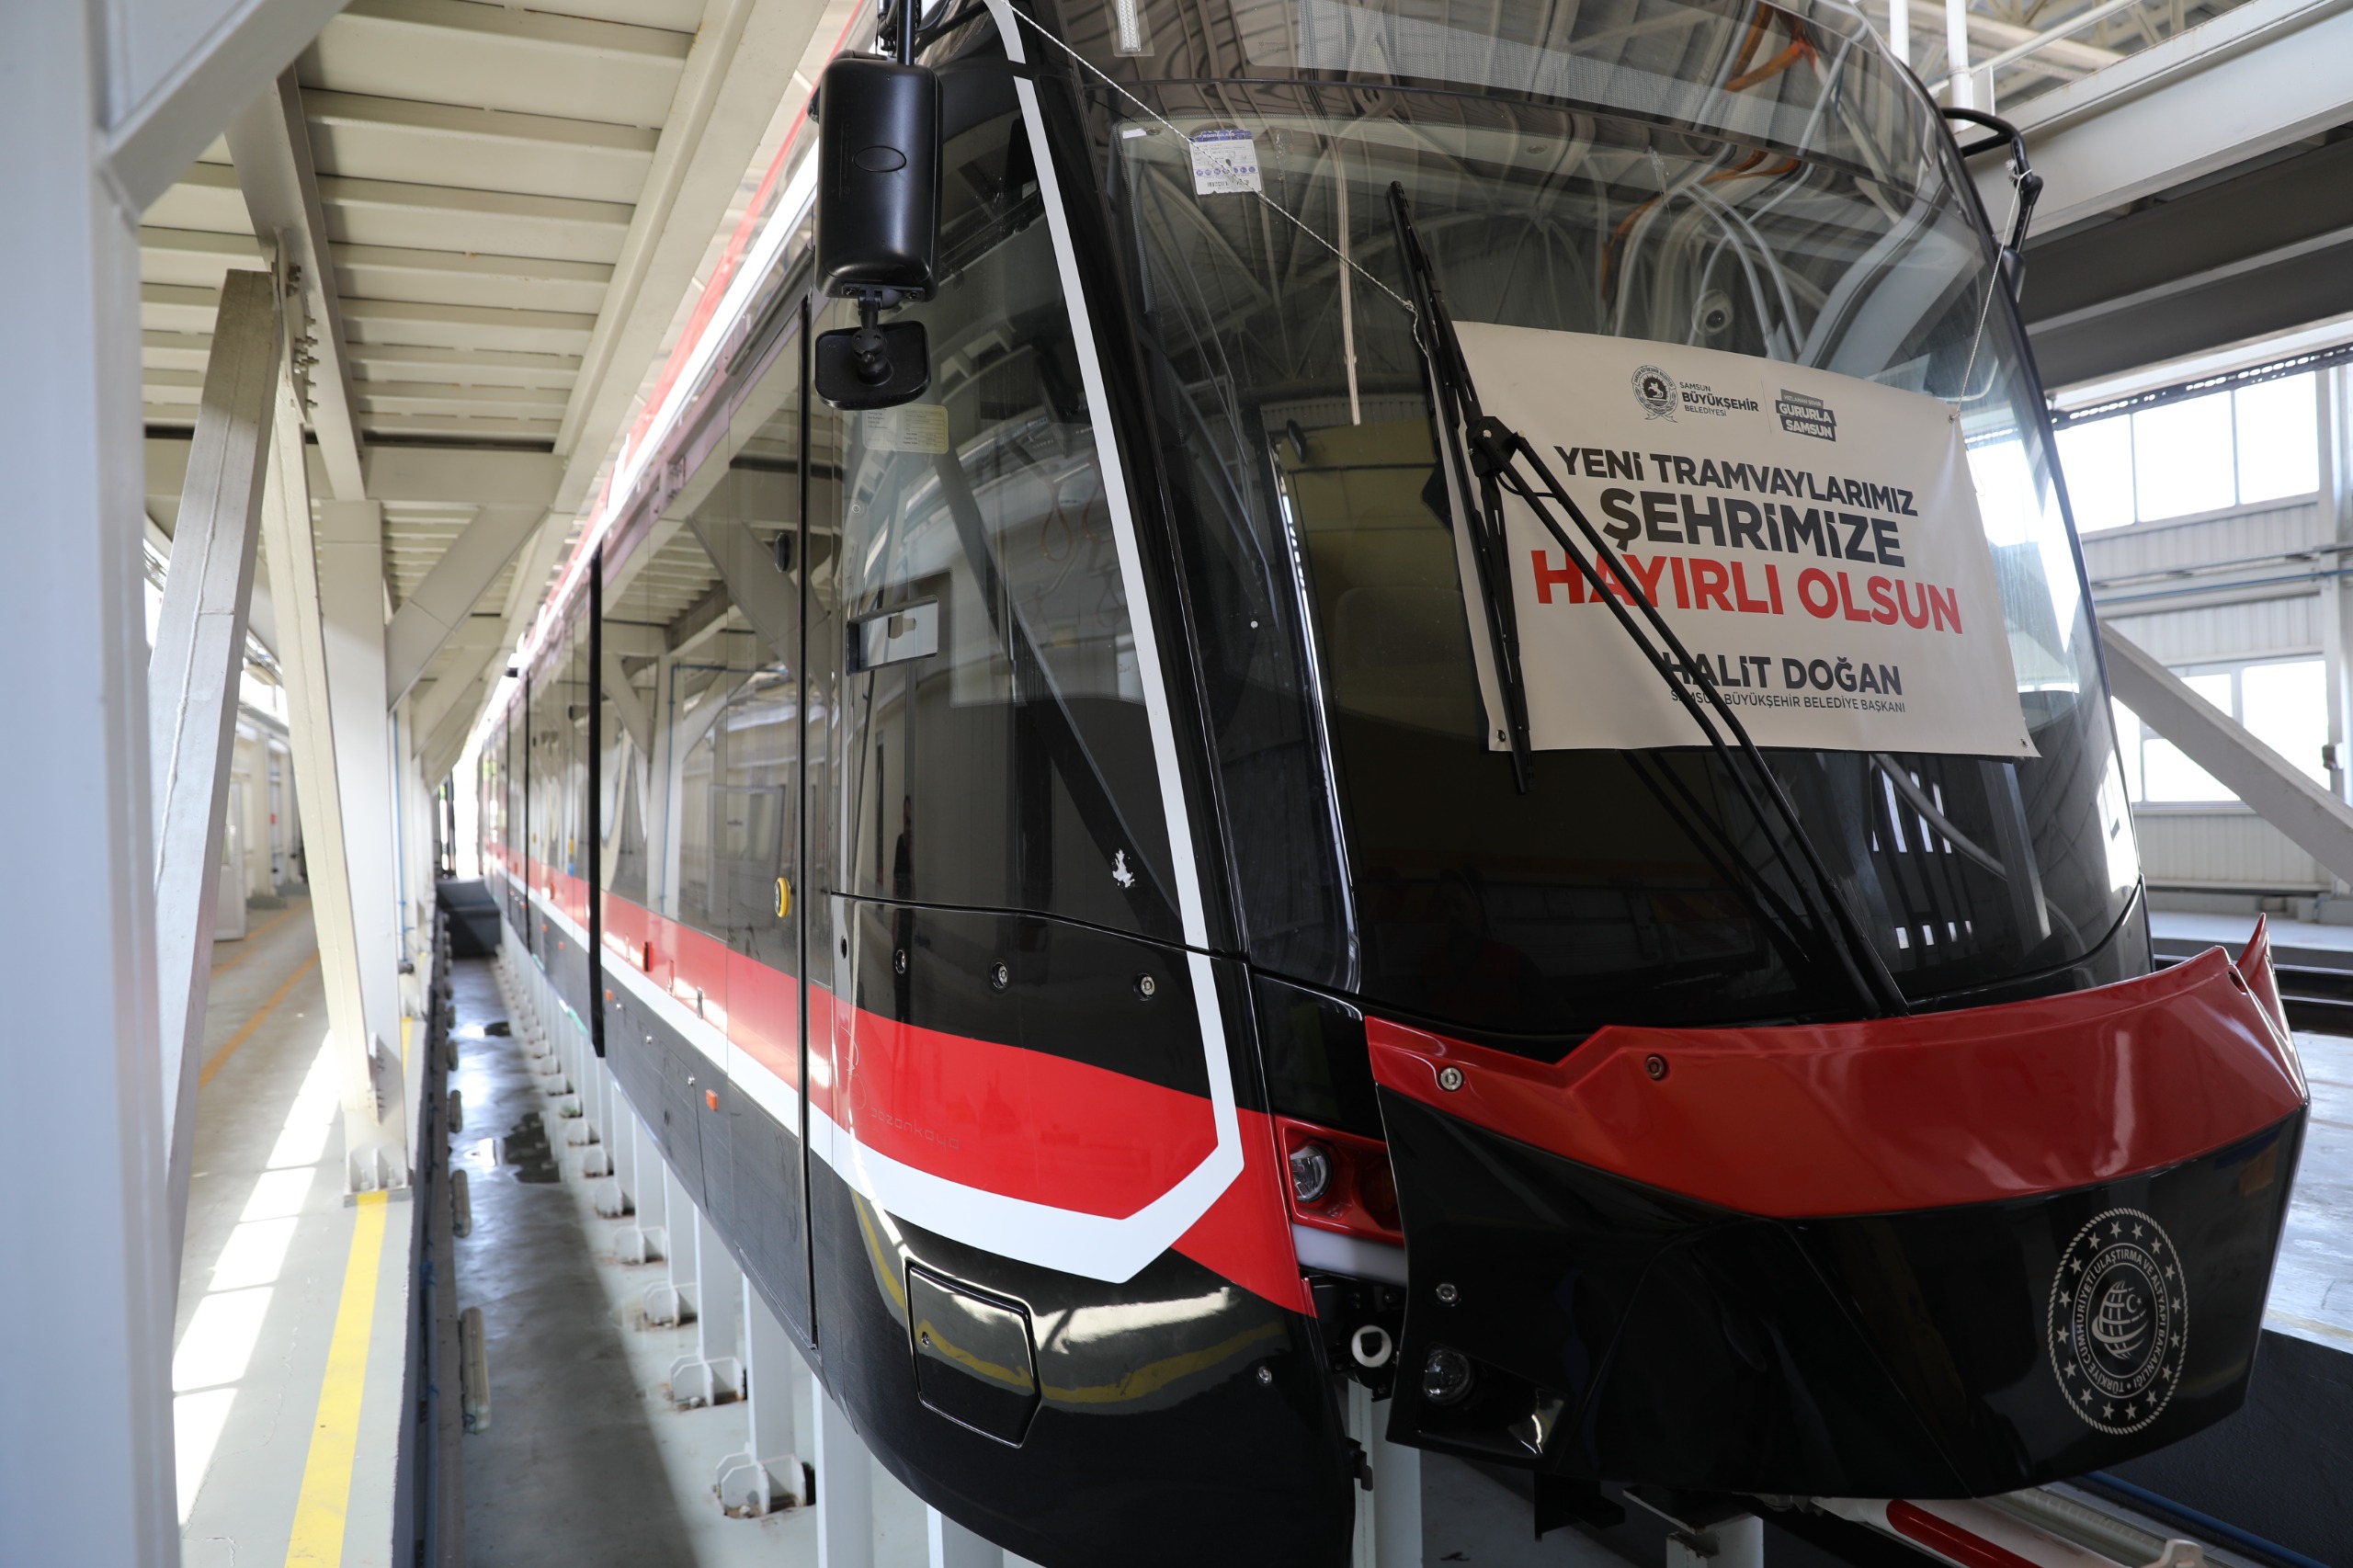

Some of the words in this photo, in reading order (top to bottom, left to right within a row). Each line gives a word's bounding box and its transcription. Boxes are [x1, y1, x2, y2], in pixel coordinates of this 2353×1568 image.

[1679, 381, 1711, 392] SAMSUN
[1682, 392, 1759, 412] BÜYÜKŞEHİR
[1684, 404, 1727, 417] BELEDİYESİ
[1779, 403, 1832, 424] GURURLA
[1785, 419, 1833, 438] SAMSUN
[1553, 446, 1644, 481] YENİ
[1650, 453, 1918, 517] TRAMVAYLARIMIZ
[1600, 488, 1905, 568] ŞEHRİMİZE
[1530, 550, 1785, 615] HAYIRLI
[1797, 567, 1963, 634] OLSUN
[1782, 655, 1904, 696] DOĞAN
[1724, 692, 1802, 709] BÜYÜKŞEHİR
[1804, 696, 1859, 710] BELEDİYE
[1861, 699, 1906, 713] BAŞKANI
[2096, 1248, 2143, 1274] ULAŞTIRMA
[2143, 1261, 2154, 1276] VE
[2151, 1274, 2166, 1326] ALTYAPI
[2076, 1270, 2097, 1365] CUMHURİYETİ
[2132, 1328, 2166, 1390] BAKANLIĞI
[2087, 1363, 2124, 1394] TÜRKİYE
